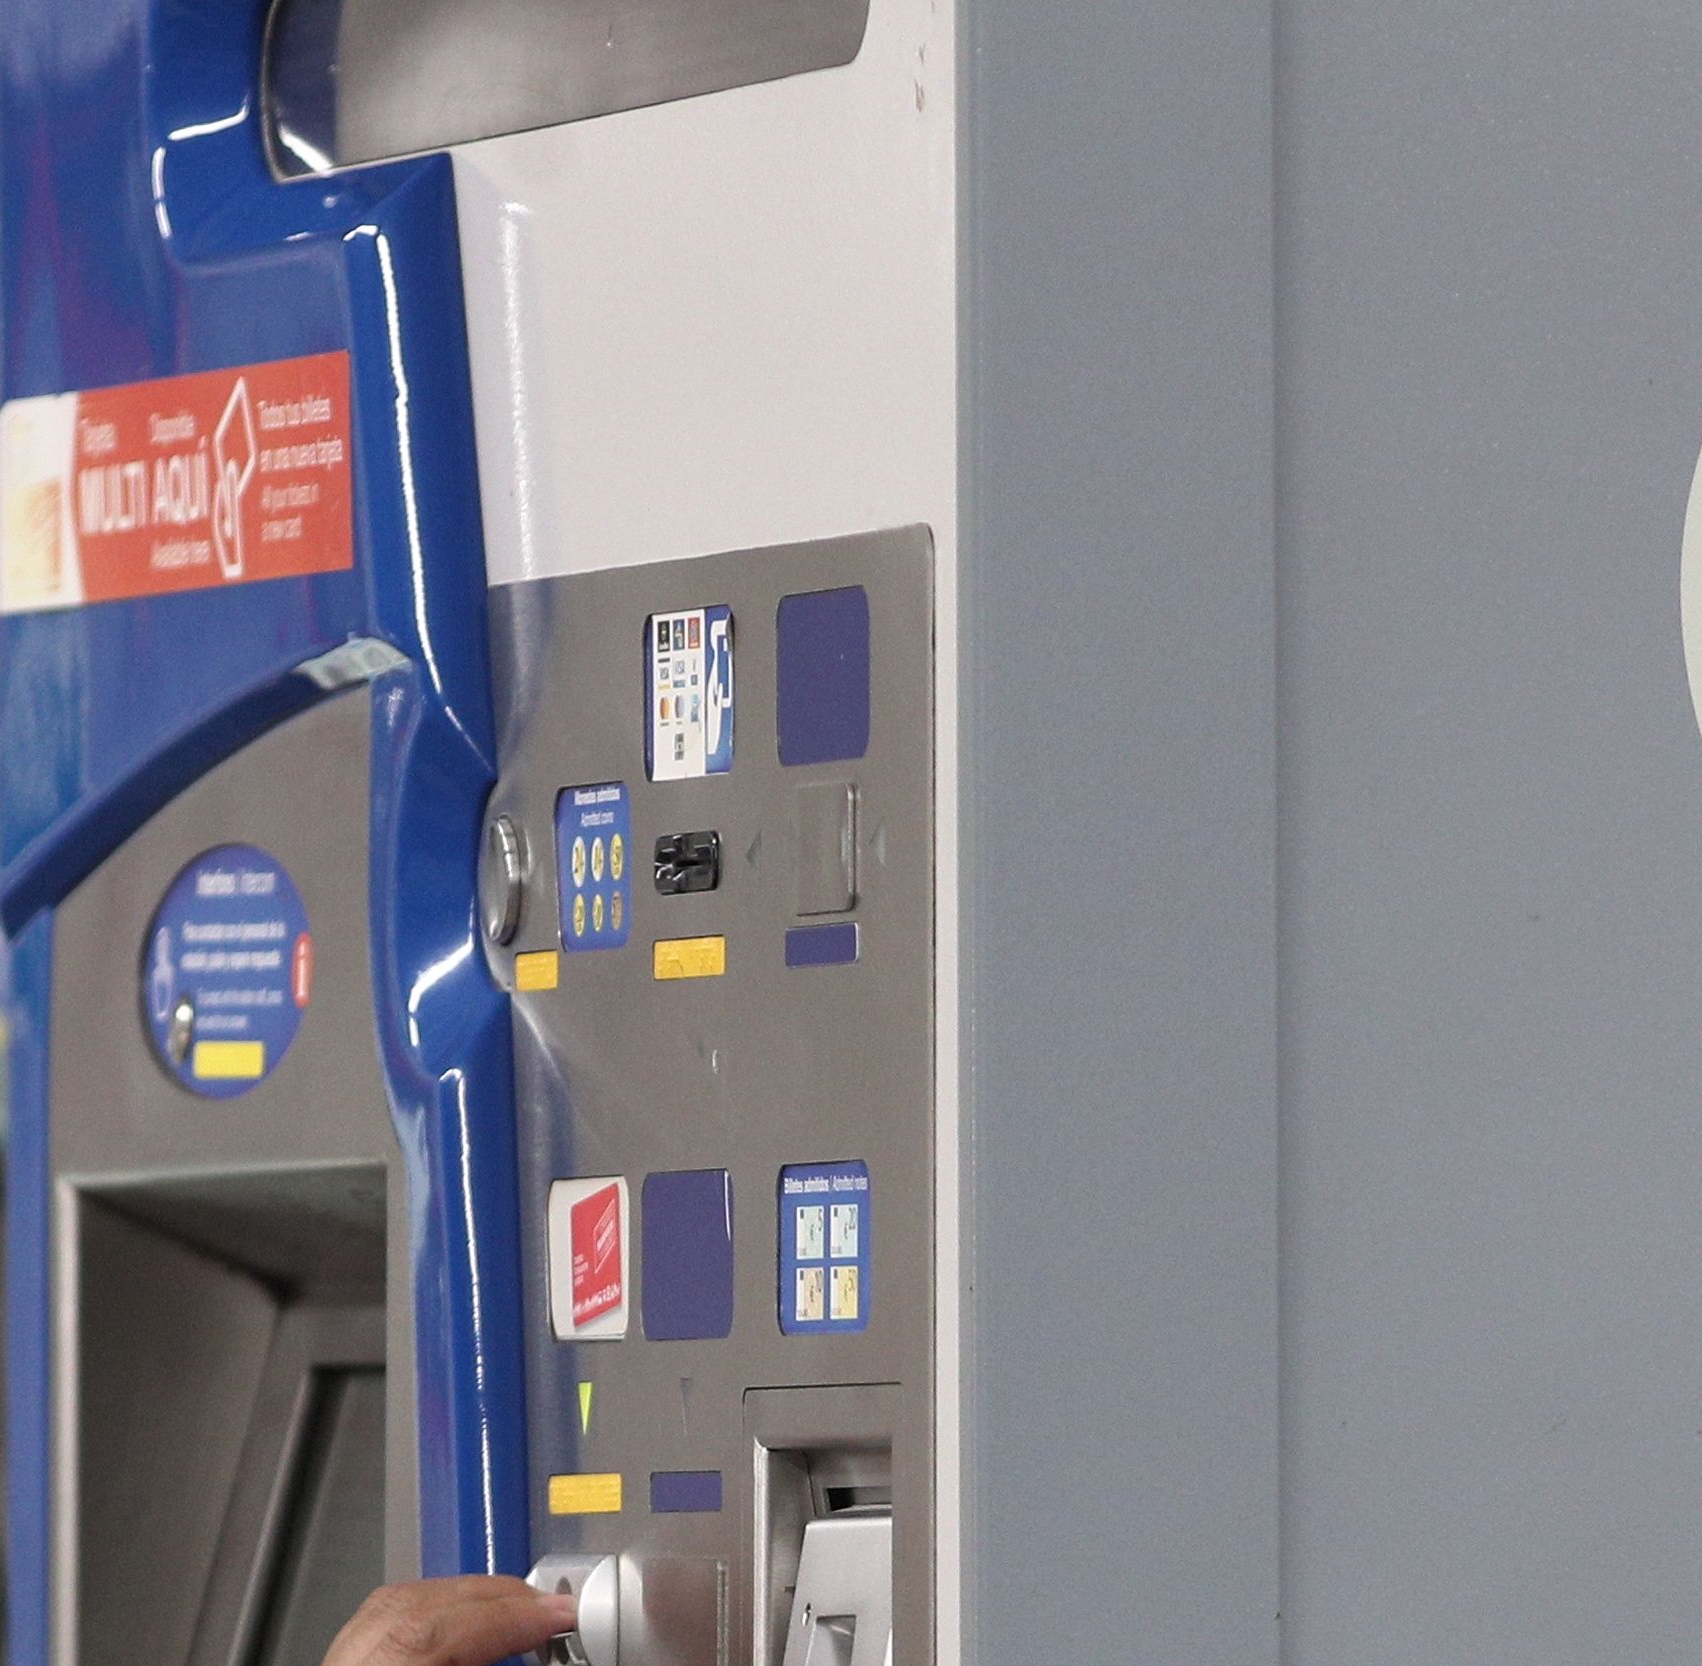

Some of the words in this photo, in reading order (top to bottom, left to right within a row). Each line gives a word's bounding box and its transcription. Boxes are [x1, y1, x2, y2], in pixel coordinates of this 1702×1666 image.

[80, 459, 146, 535] MULTI
[151, 435, 208, 524] AQUÍ
[784, 1177, 803, 1194] Billetes
